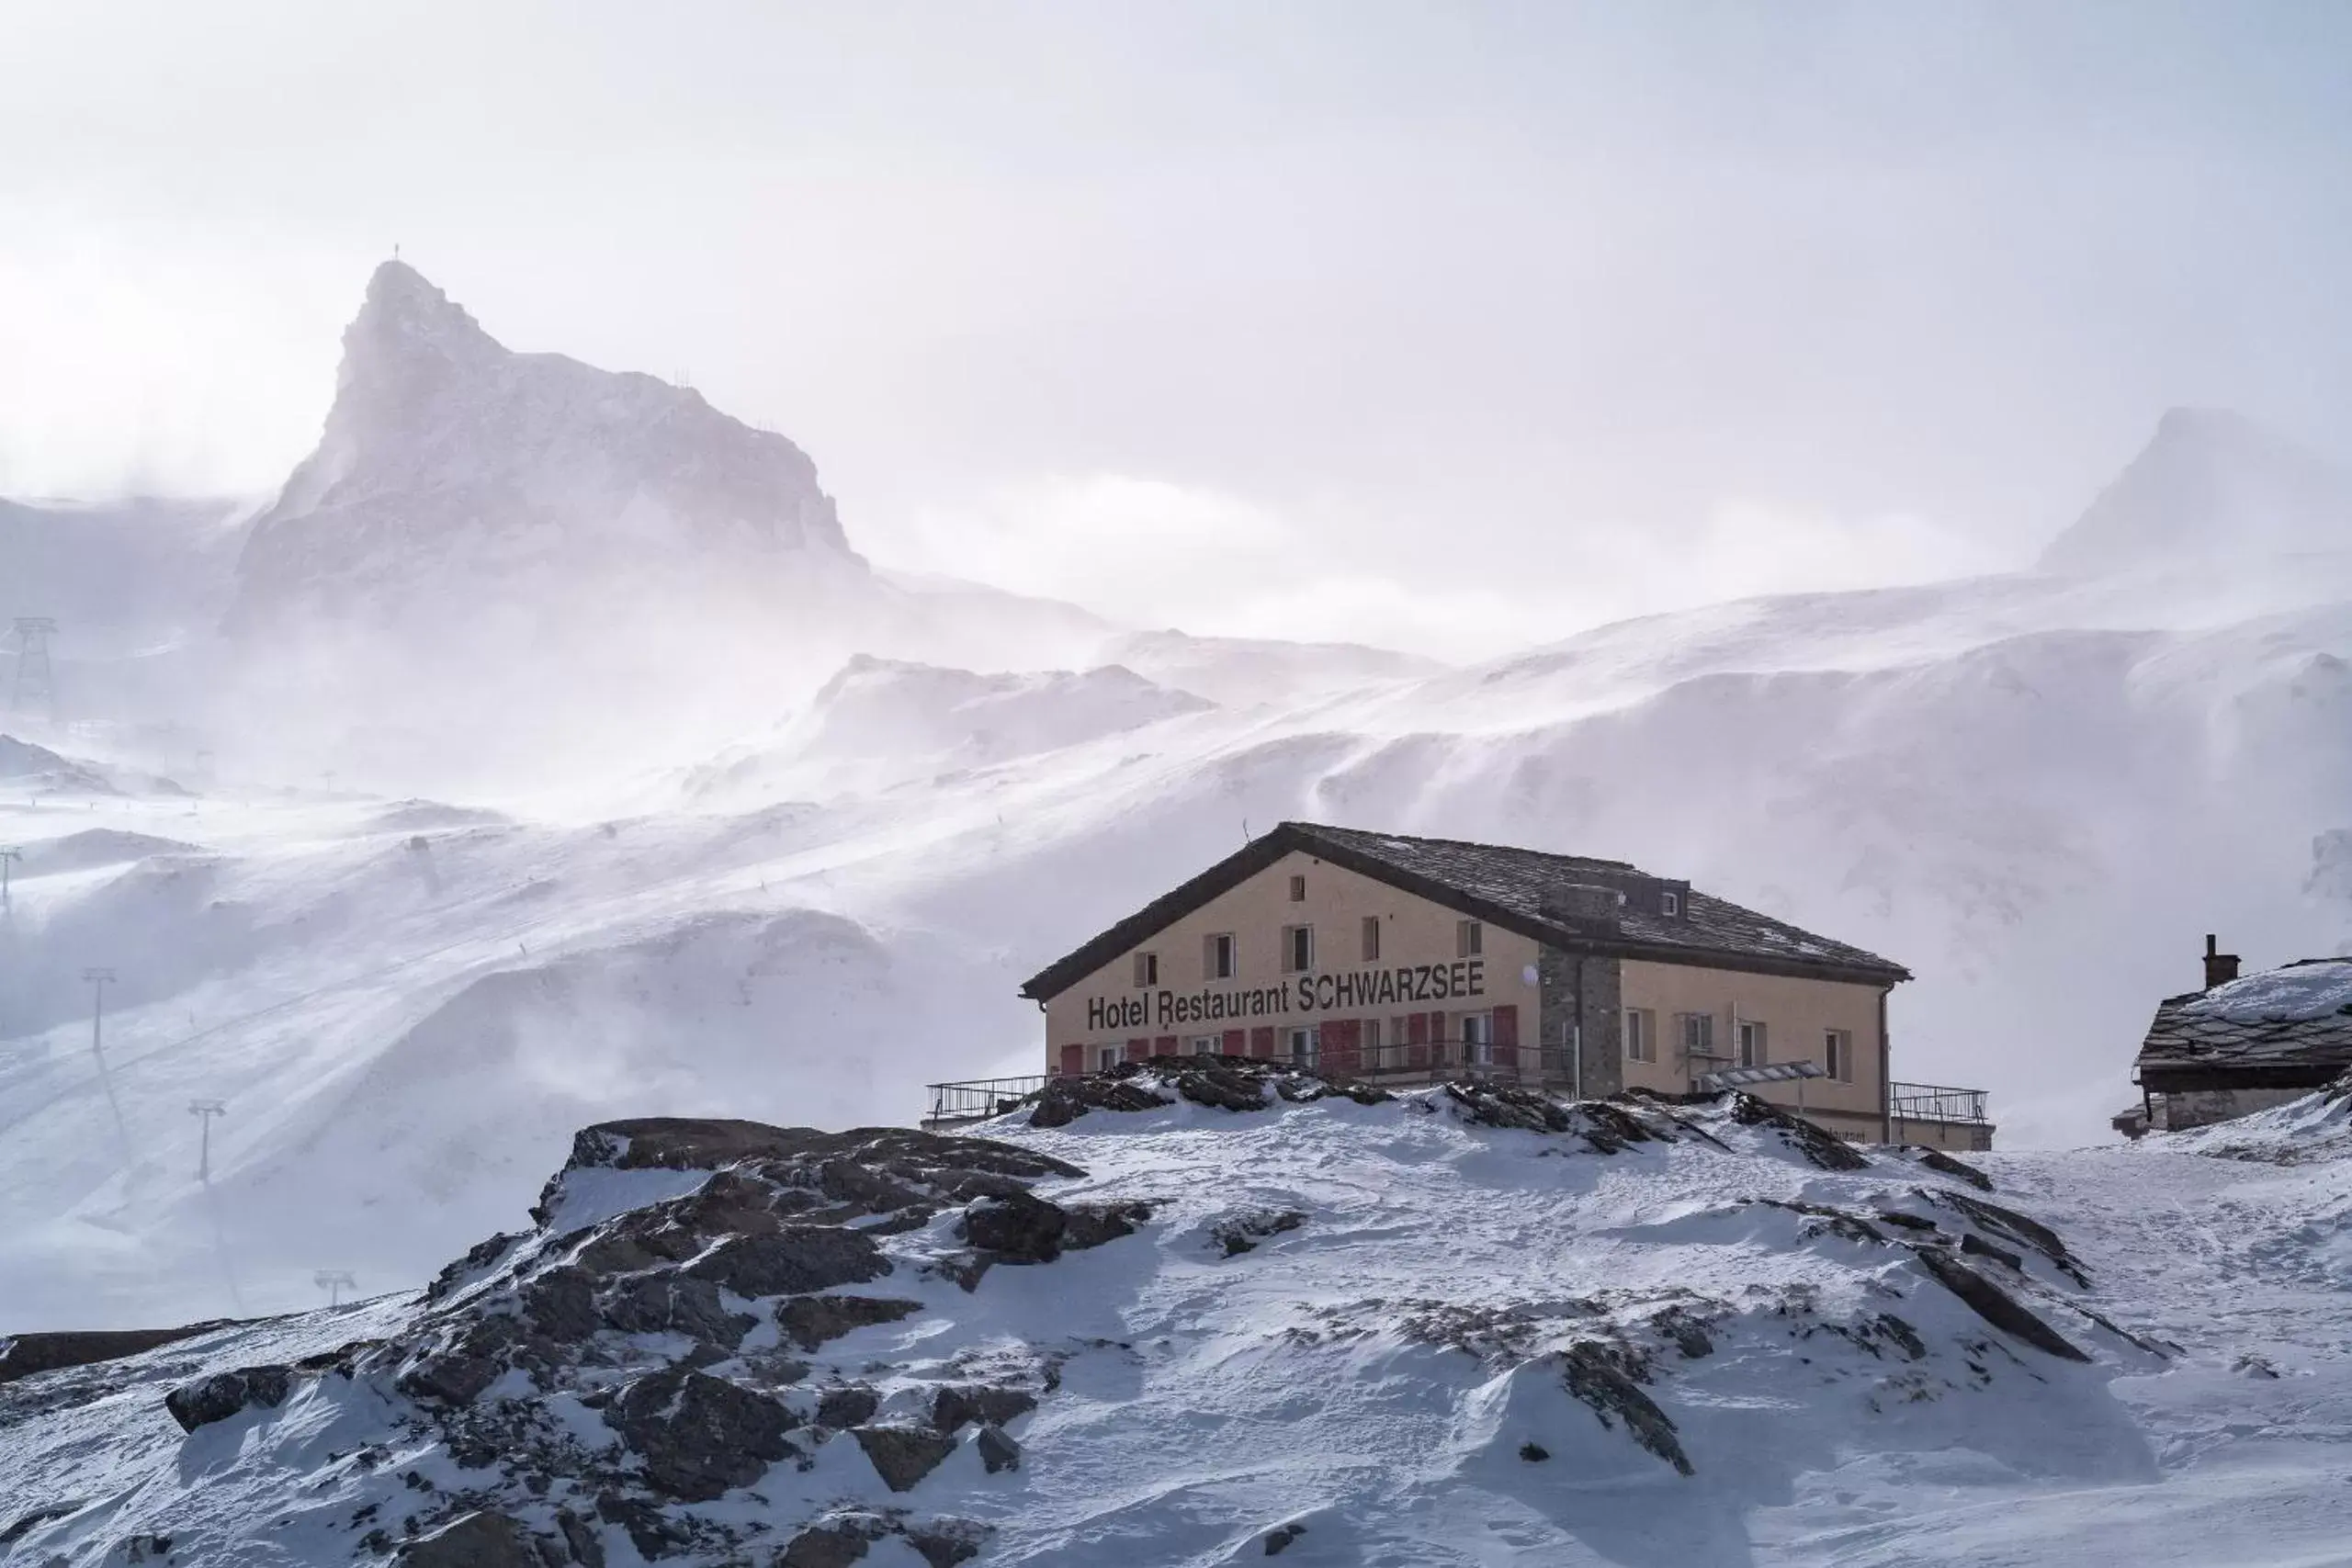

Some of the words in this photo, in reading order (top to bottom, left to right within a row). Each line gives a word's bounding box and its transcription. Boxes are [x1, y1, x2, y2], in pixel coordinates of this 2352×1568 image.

[1089, 993, 1148, 1030] Hotel
[1158, 981, 1289, 1024] Restaurant
[1298, 961, 1484, 1011] SCHWARZSEE
